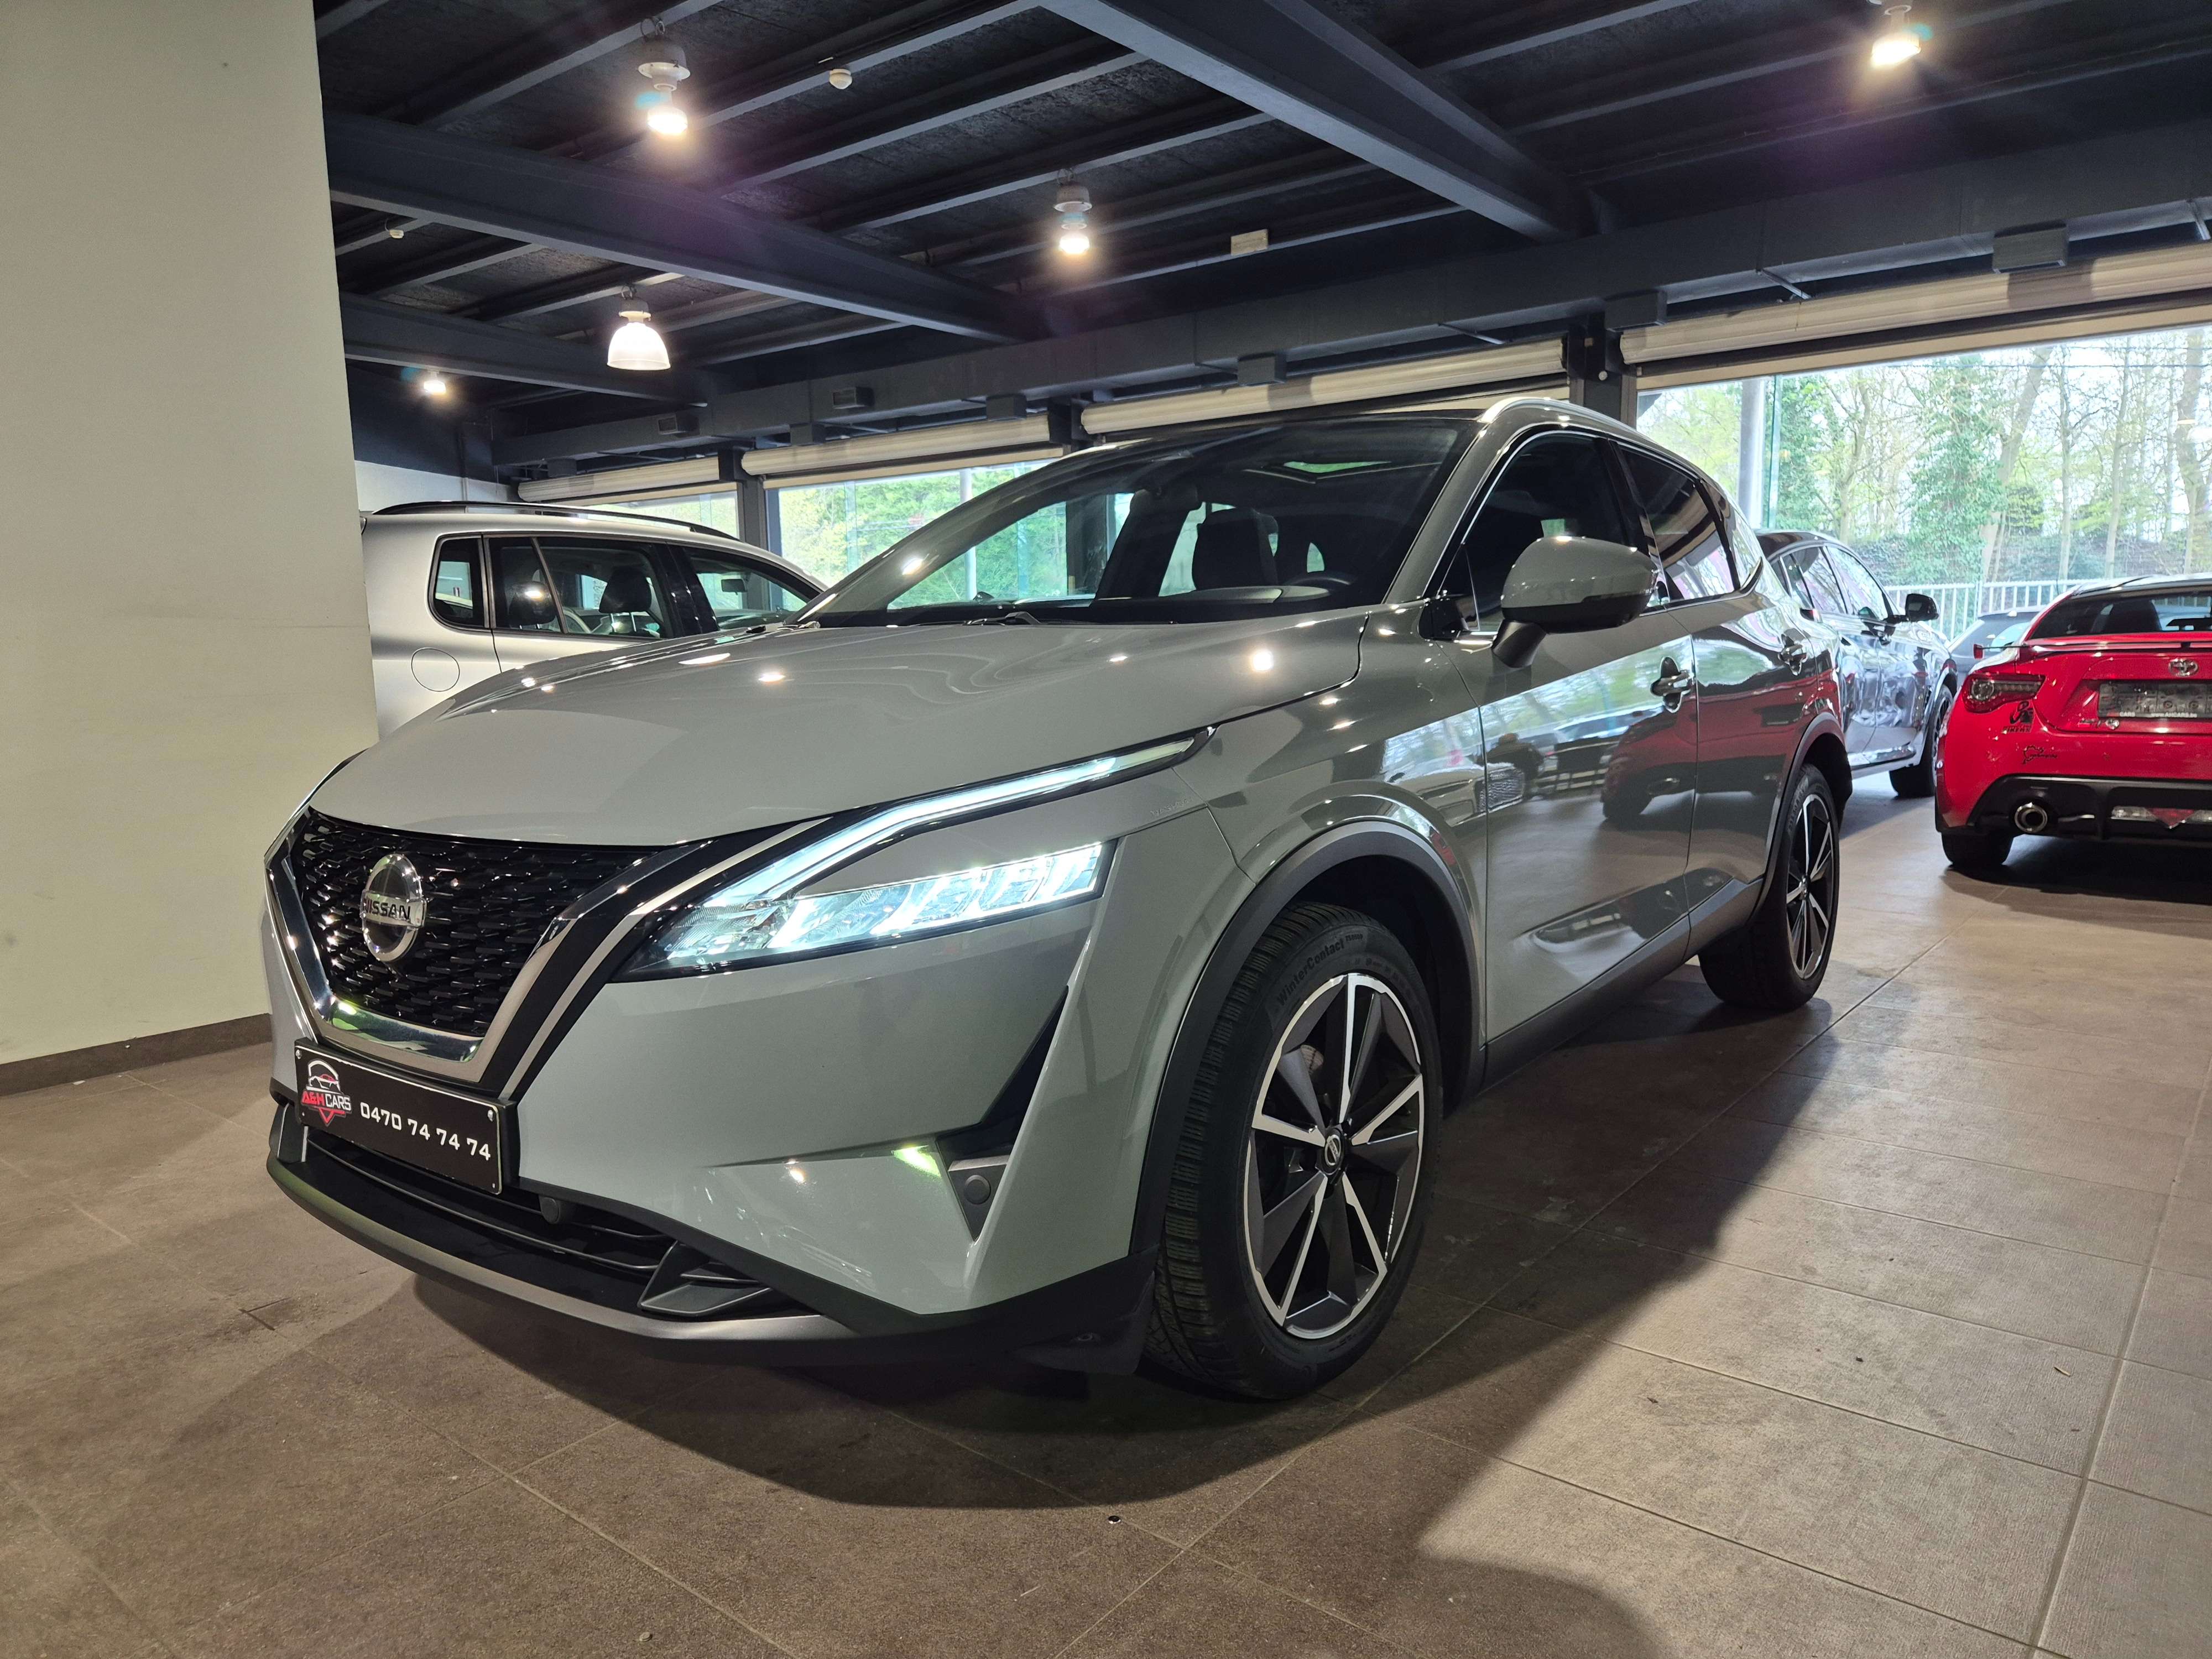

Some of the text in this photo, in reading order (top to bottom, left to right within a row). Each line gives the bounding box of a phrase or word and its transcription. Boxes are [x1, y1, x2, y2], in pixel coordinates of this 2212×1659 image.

[363, 898, 411, 921] NISSAN
[1277, 939, 1344, 1006] WinterContact
[360, 1102, 491, 1161] 0470 74 74 74
